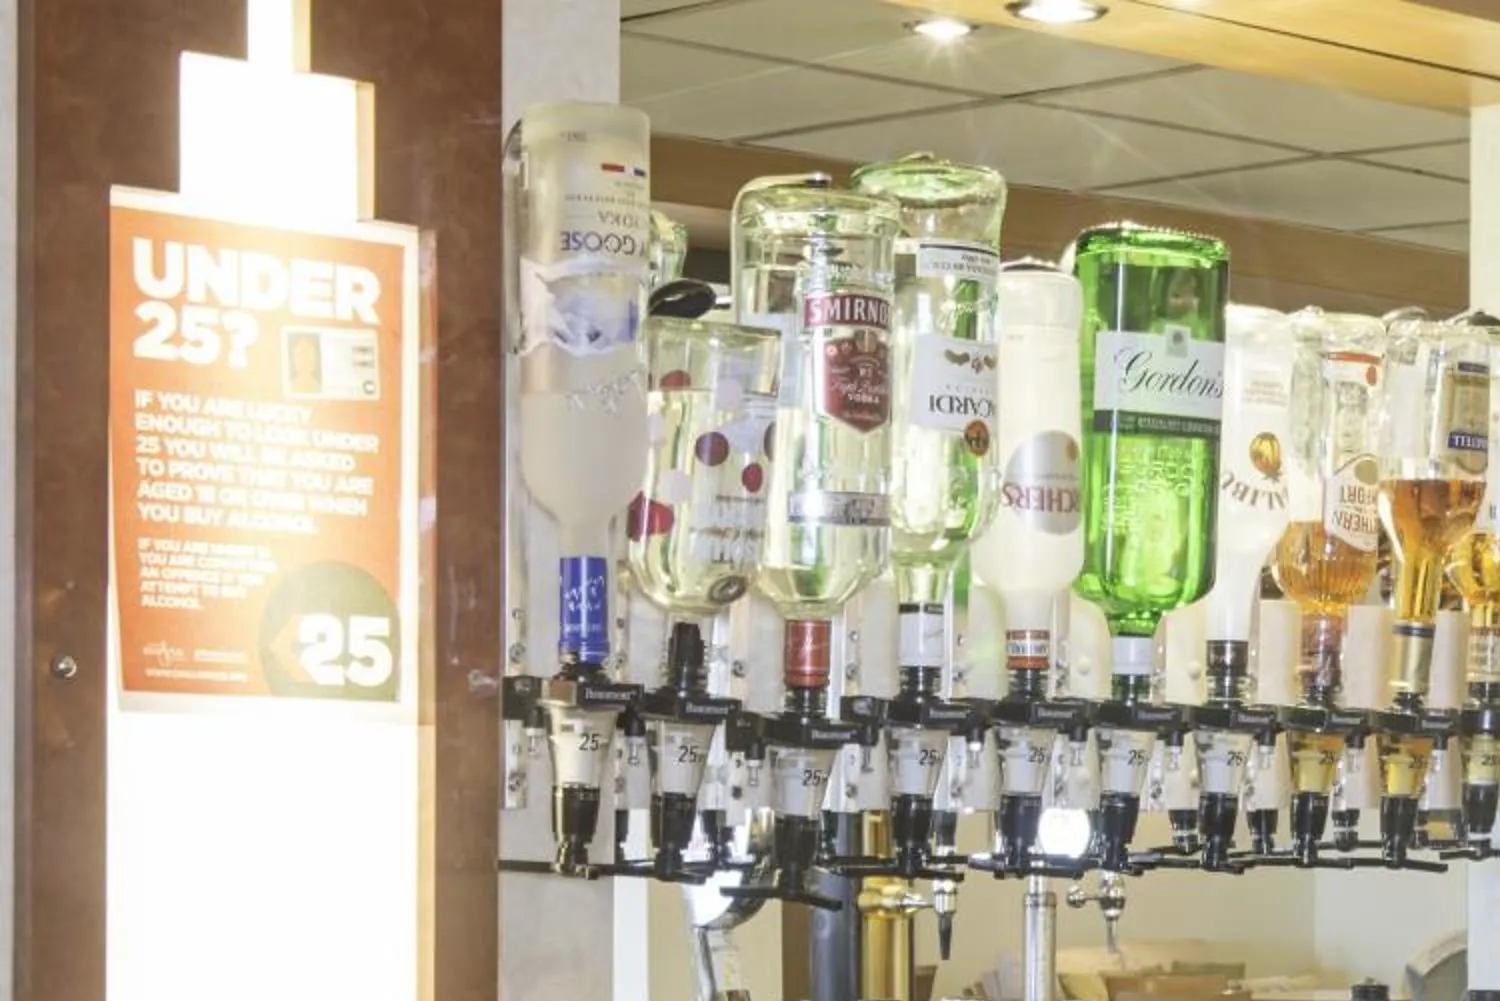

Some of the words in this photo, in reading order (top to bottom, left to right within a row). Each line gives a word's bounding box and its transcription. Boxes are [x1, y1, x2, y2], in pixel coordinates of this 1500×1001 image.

[132, 237, 381, 325] UNDER
[133, 301, 259, 369] 25?
[135, 390, 153, 408] IF
[158, 392, 200, 413] YOU
[165, 438, 206, 458] YOU
[136, 458, 165, 477] TO
[138, 481, 193, 500] AGED
[138, 503, 180, 521] YOU
[297, 612, 393, 686] 25
[578, 733, 599, 751] 25
[679, 745, 698, 763] 25
[803, 769, 822, 787] 25
